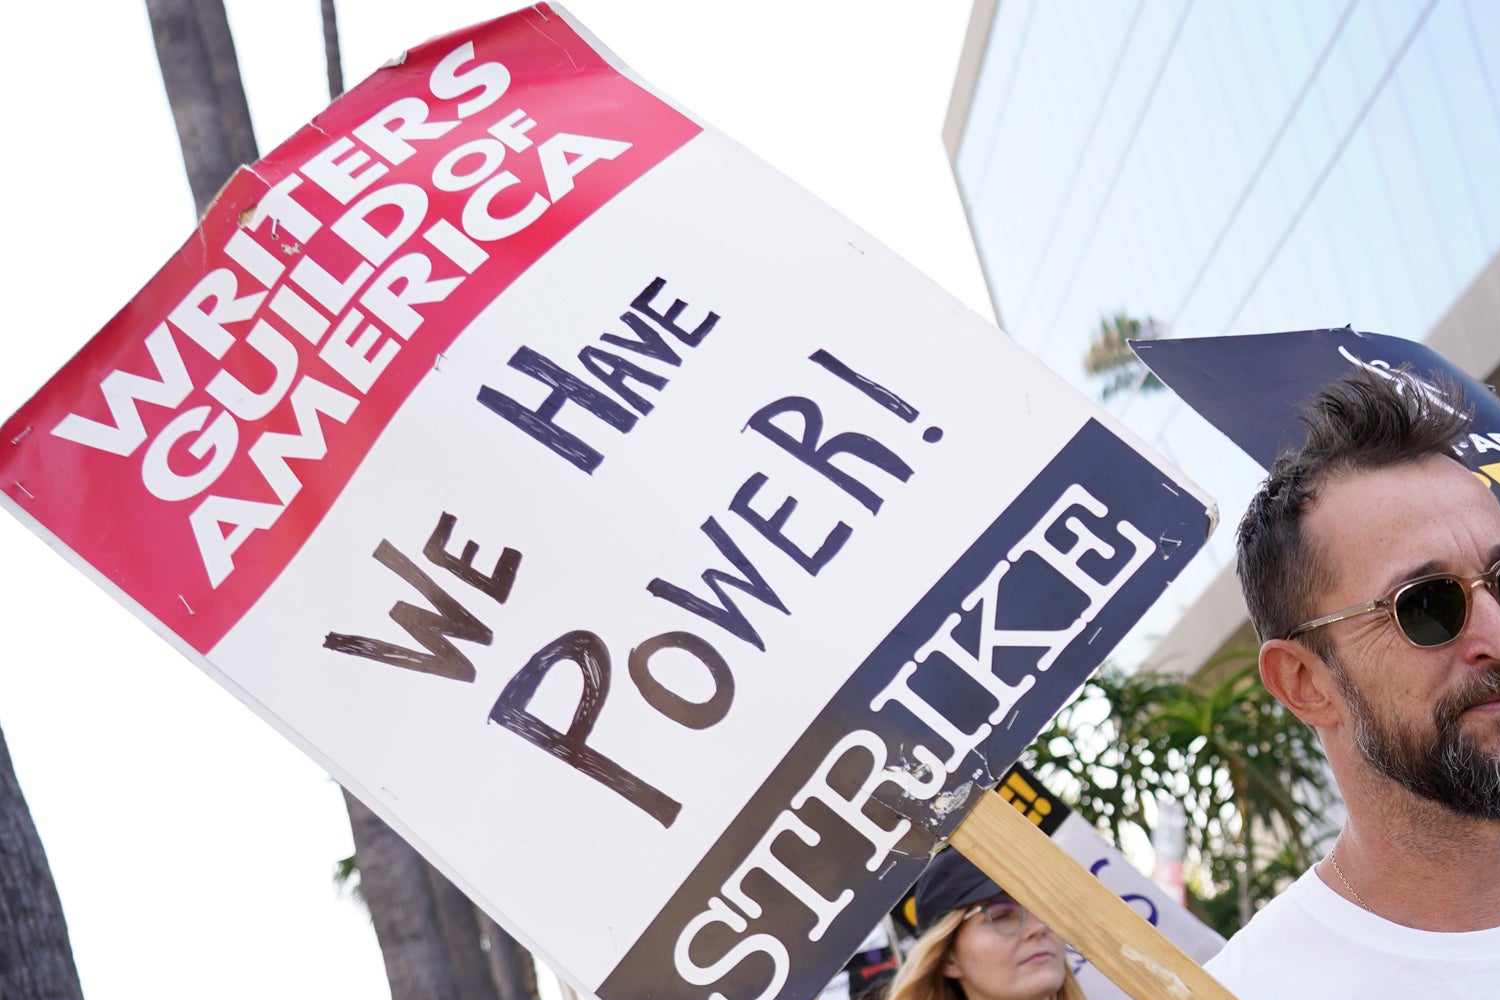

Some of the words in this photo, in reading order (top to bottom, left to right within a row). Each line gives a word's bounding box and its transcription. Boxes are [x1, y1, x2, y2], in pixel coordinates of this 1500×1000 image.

[50, 41, 511, 456] WRITERS
[141, 183, 429, 501] GUILD
[432, 108, 536, 192] OF
[189, 132, 633, 589] AMERICA
[322, 511, 523, 682] WE
[476, 276, 721, 475] HAVE
[487, 348, 944, 828] POWER!
